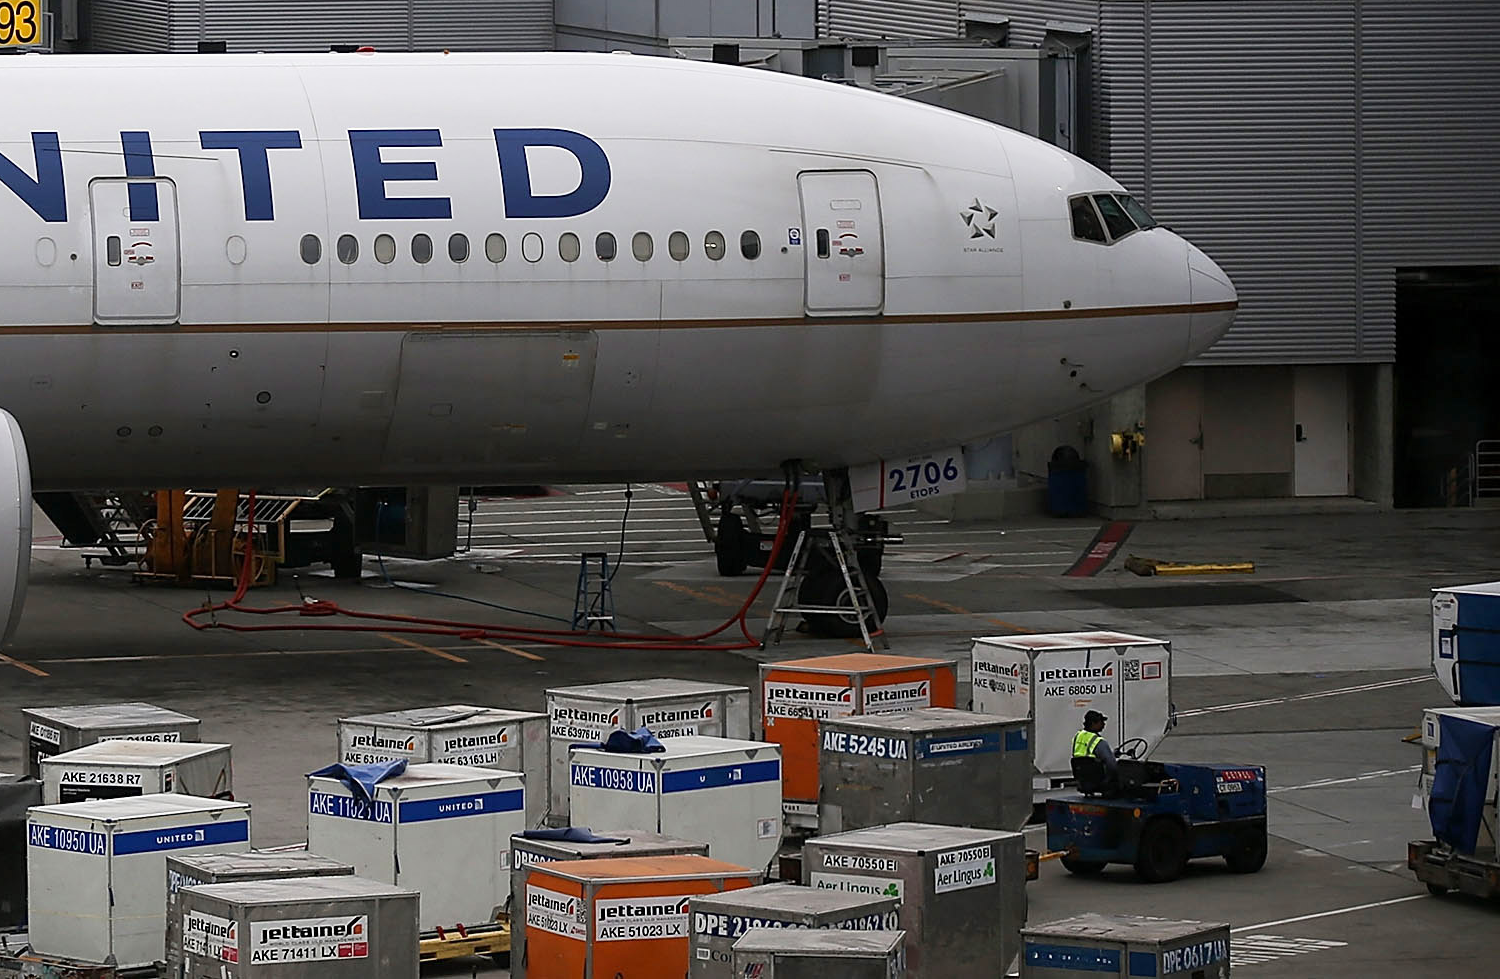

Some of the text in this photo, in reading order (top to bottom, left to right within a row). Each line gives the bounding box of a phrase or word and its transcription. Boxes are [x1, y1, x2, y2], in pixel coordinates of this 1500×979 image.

[888, 457, 958, 493] 2706
[910, 486, 940, 499] ETOPS
[974, 661, 1017, 677] jettainer
[1039, 661, 1113, 682] jettainer
[767, 688, 853, 702] jettainer
[865, 680, 927, 706] jettainer
[1044, 684, 1113, 697] AKE 68050 LH
[552, 707, 619, 724] jettainer
[642, 702, 712, 723] jettainer
[767, 705, 786, 716] AKE
[816, 709, 829, 719] LH
[444, 728, 507, 753] jettainer
[551, 725, 567, 736] AKE
[567, 727, 590, 739] 63976
[823, 731, 908, 760] AKE 5245 UA
[345, 752, 362, 763] AKE
[457, 755, 484, 766] 63163
[484, 753, 497, 764] LH
[62, 772, 141, 785] AKE 21638 R7
[574, 765, 654, 793] AKE 10958 UA
[312, 793, 334, 815] AKE
[375, 801, 391, 823] UA
[439, 801, 473, 812] UNITED
[31, 825, 105, 855] AKE 10950 UA
[156, 832, 194, 845] UNITED
[824, 855, 848, 867] AKE
[852, 857, 885, 870] 70550
[937, 868, 981, 886] Aer Lingus
[528, 894, 574, 914] jettainer
[599, 897, 690, 921] jettainer
[187, 918, 236, 939] jettainer
[260, 916, 363, 944] jettainer
[559, 921, 568, 934] LX
[601, 924, 681, 939] AKE 51023 LX
[694, 912, 728, 936] DPE
[252, 949, 279, 962] AKE
[282, 947, 316, 960] 71411
[321, 945, 337, 958] LX
[1163, 939, 1227, 974] DPE 0617 UA
